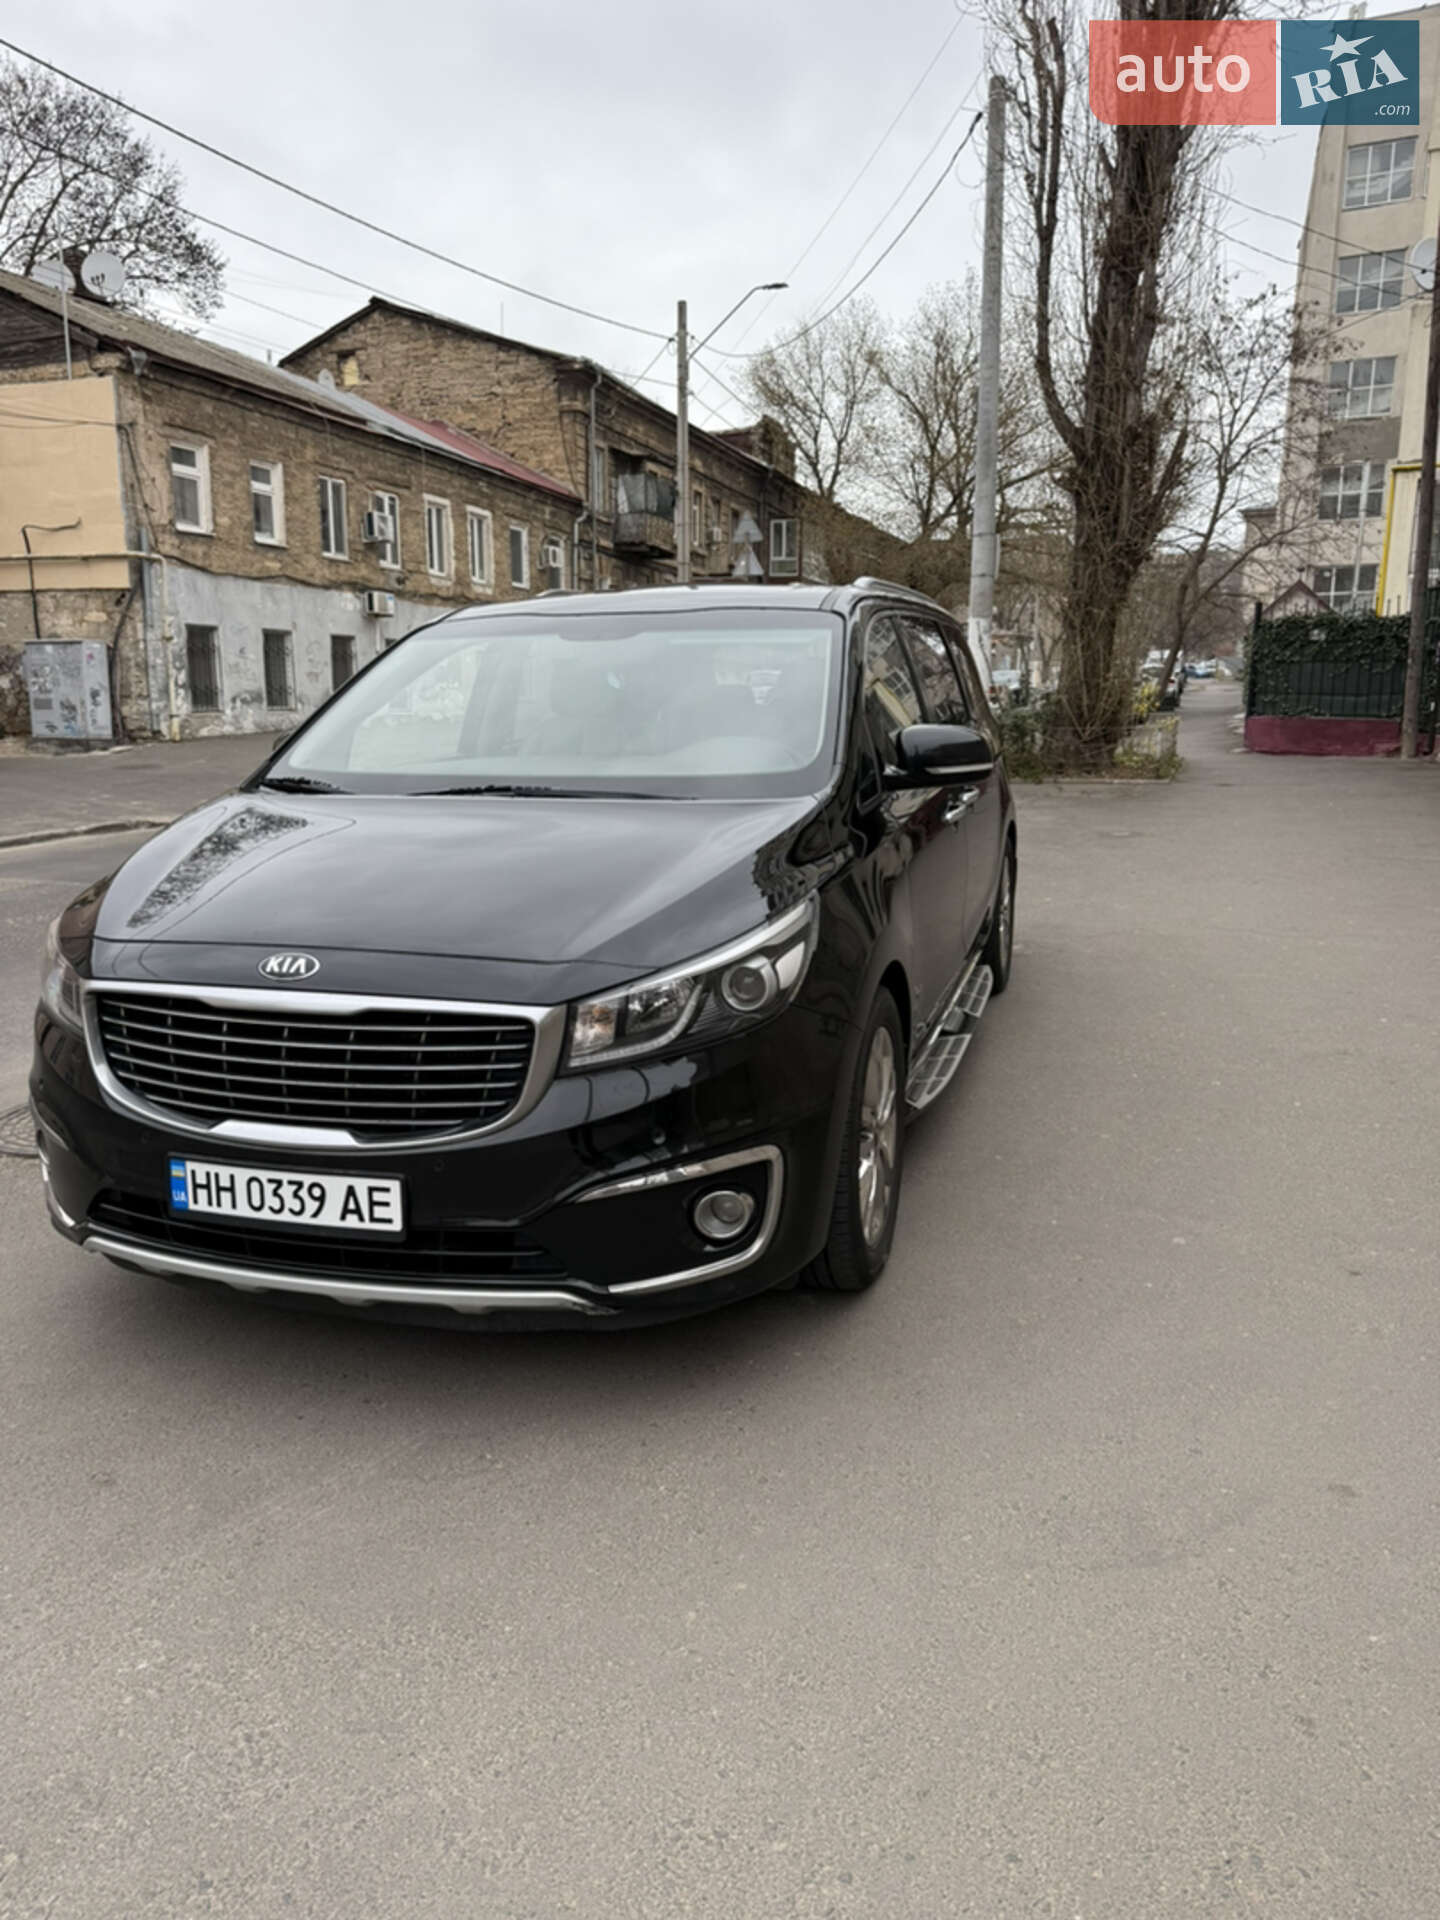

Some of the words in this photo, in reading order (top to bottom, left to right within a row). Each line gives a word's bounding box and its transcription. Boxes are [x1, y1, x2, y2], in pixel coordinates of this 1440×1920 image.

[265, 956, 306, 973] KIA
[172, 1189, 187, 1202] UA
[190, 1169, 237, 1210] HH
[246, 1176, 326, 1219] 0339
[339, 1184, 394, 1225] AE
